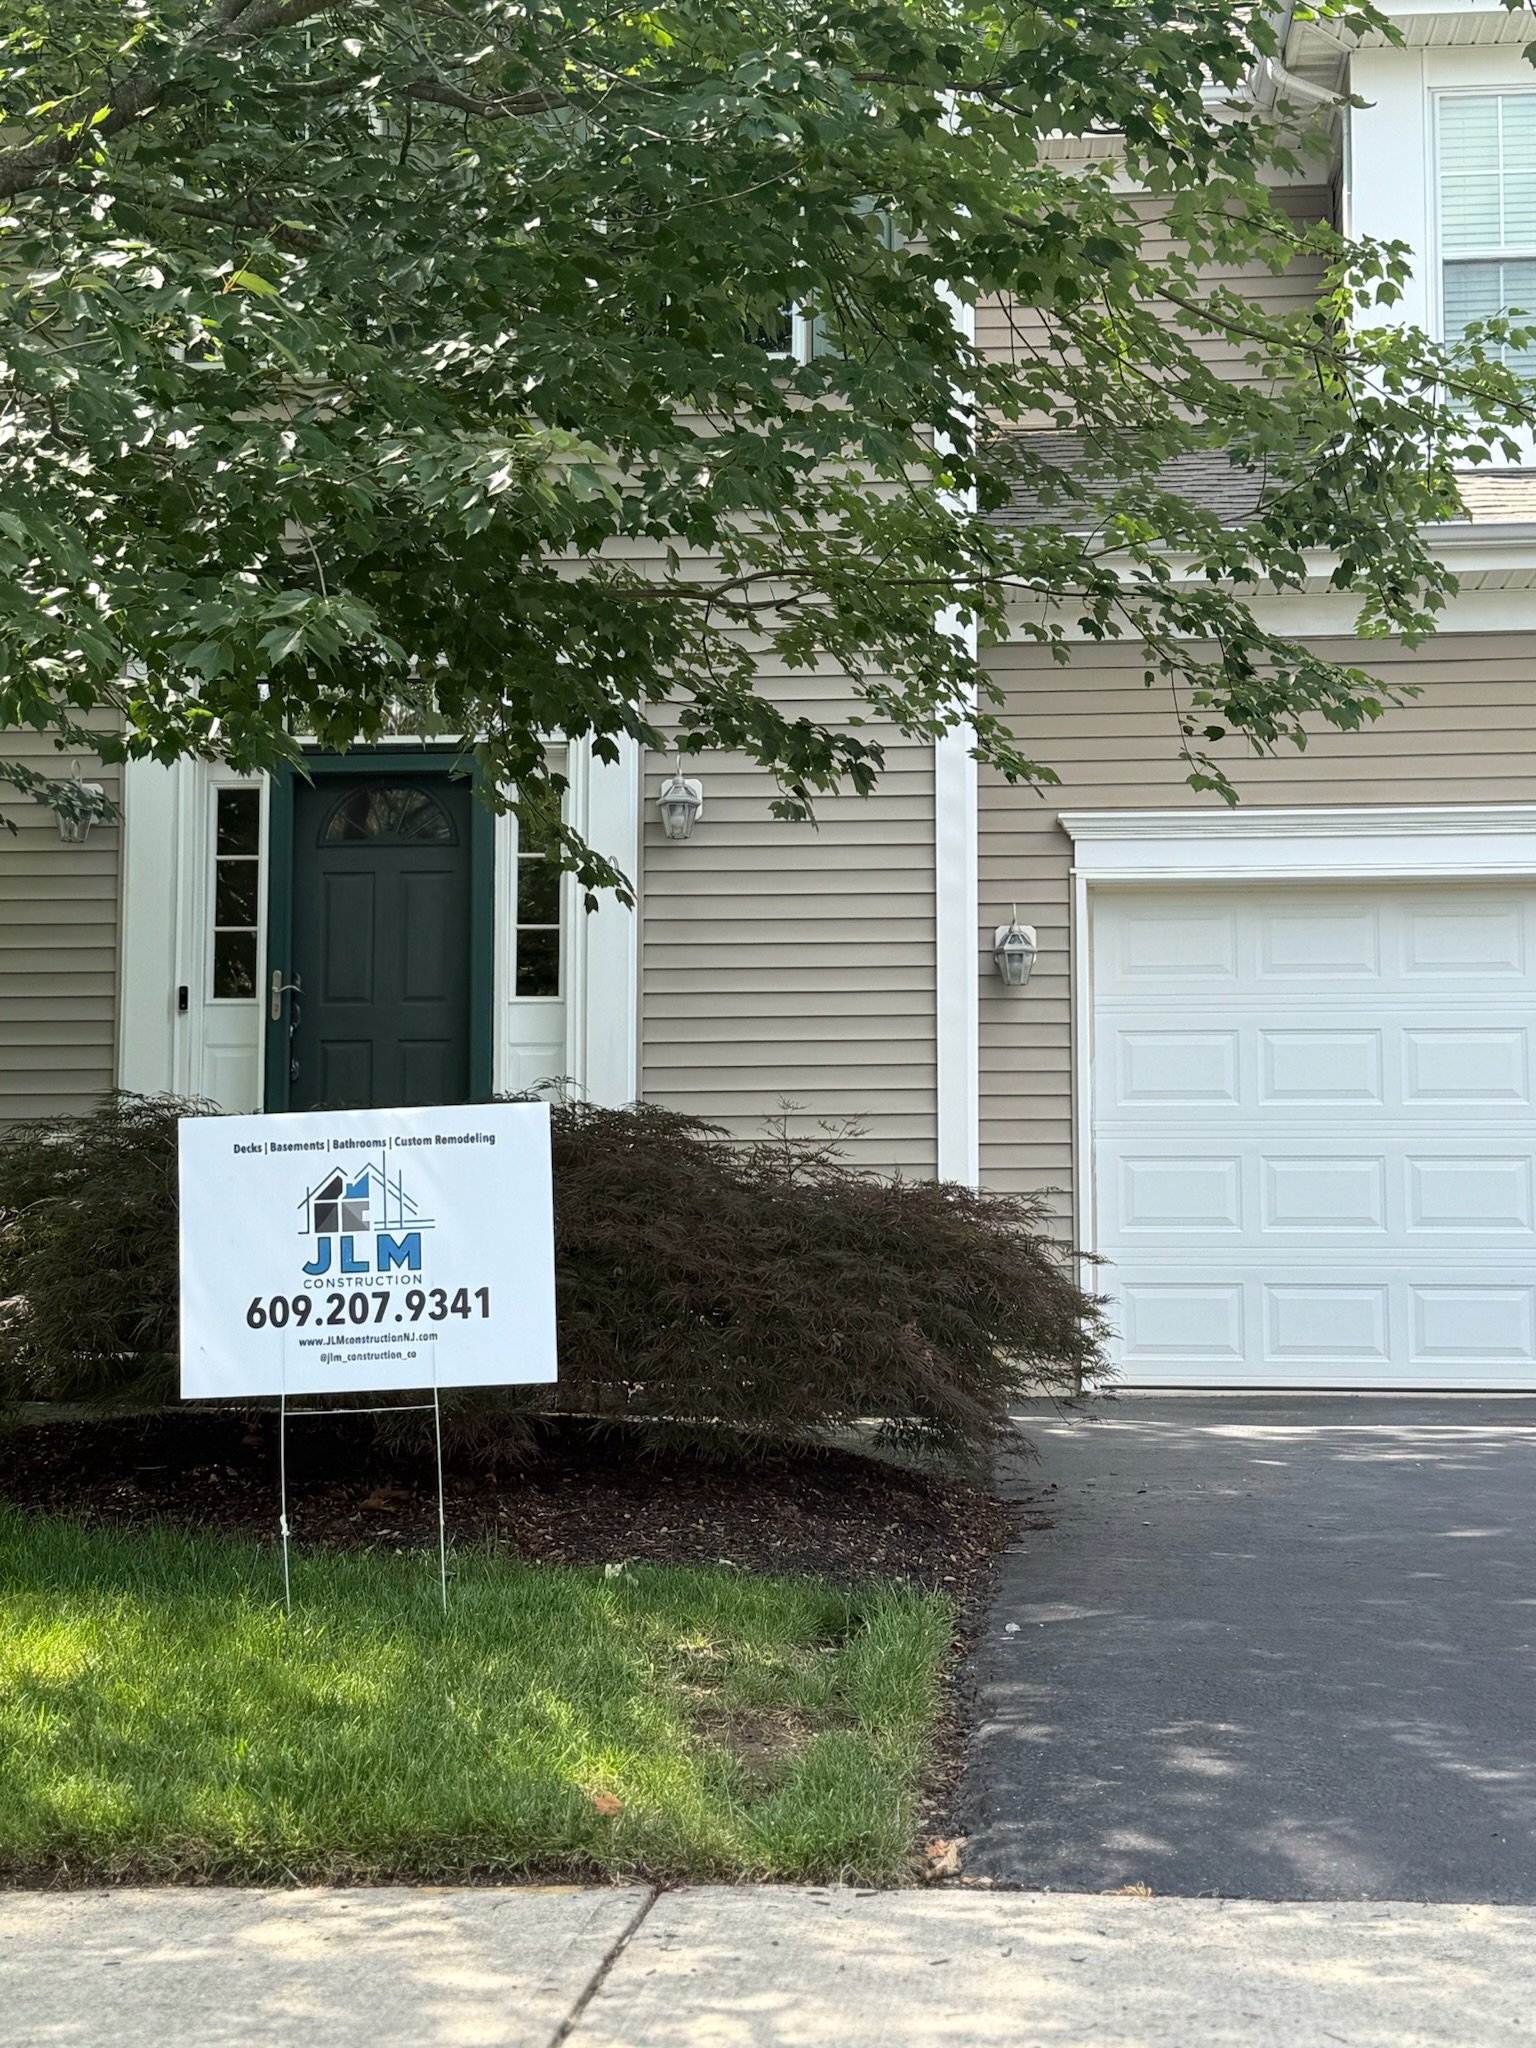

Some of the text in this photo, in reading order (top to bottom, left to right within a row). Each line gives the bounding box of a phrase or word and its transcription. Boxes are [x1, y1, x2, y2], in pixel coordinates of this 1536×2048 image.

[233, 1142, 262, 1154] Decks
[270, 1141, 325, 1152] Basements
[332, 1137, 387, 1150] Bathrooms
[394, 1136, 432, 1147] Custom
[434, 1133, 496, 1146] Remodeling
[301, 1232, 422, 1276] JLM
[303, 1274, 423, 1289] CONSTRUCTION
[246, 1286, 490, 1329] 609.207.9341
[299, 1332, 438, 1347] www.JLMconstructionNJ.com
[320, 1349, 417, 1364] @jlm_construction_co
